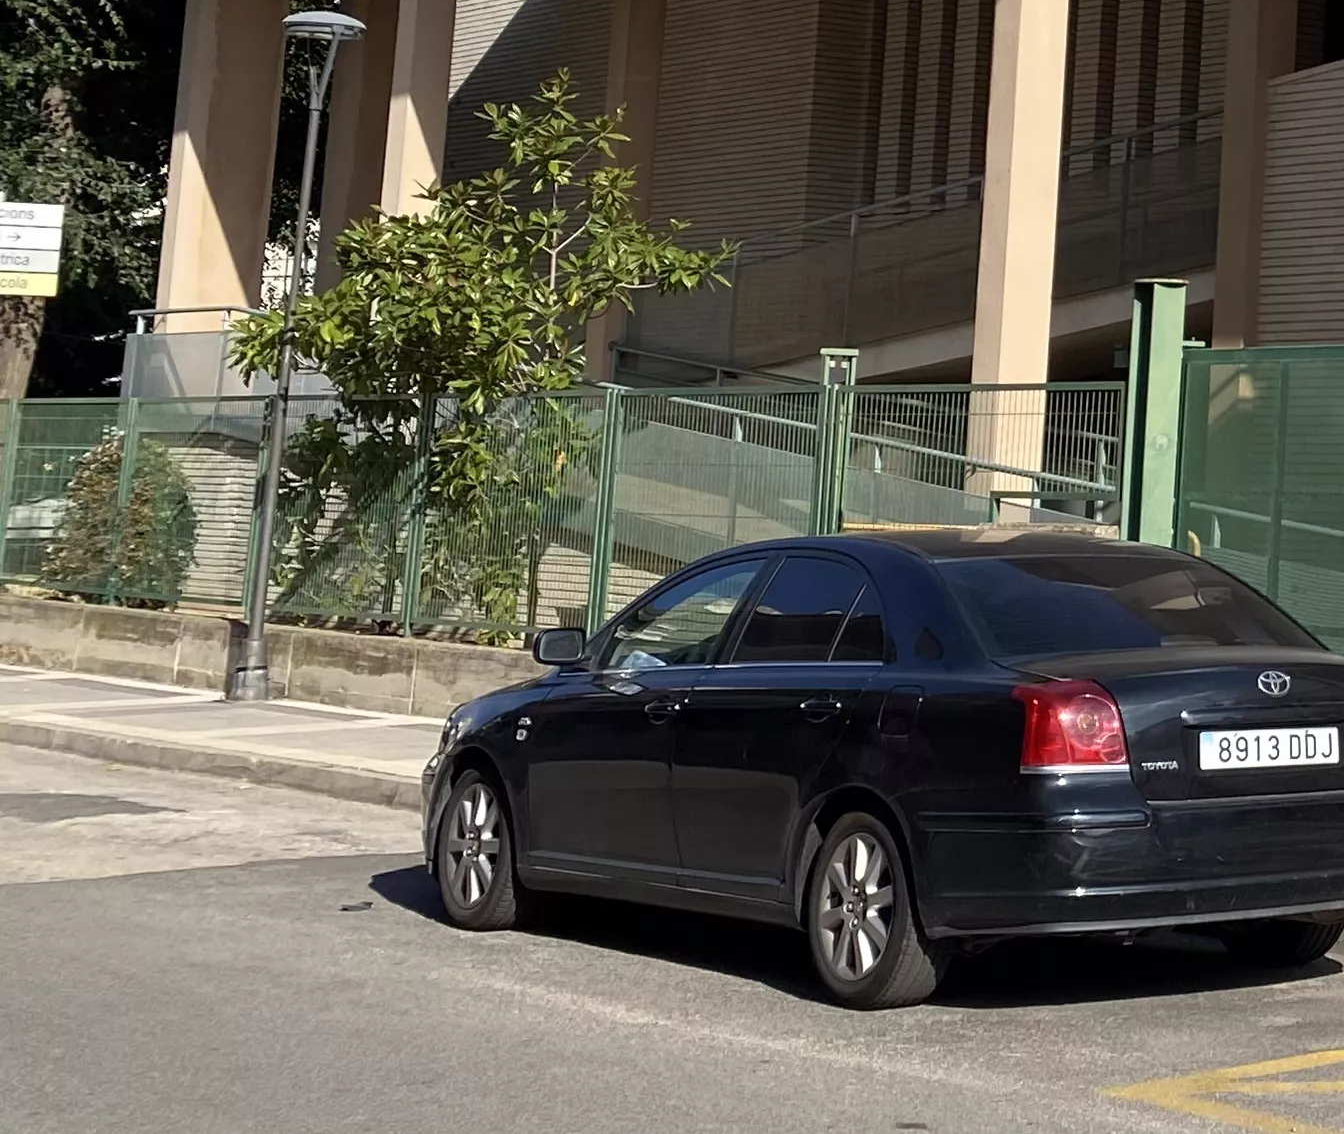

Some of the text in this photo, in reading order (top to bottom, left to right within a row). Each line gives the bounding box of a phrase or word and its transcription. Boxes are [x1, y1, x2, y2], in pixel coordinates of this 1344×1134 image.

[1219, 733, 1333, 762] 8913 DDJ
[1141, 760, 1179, 771] TOYOTA
